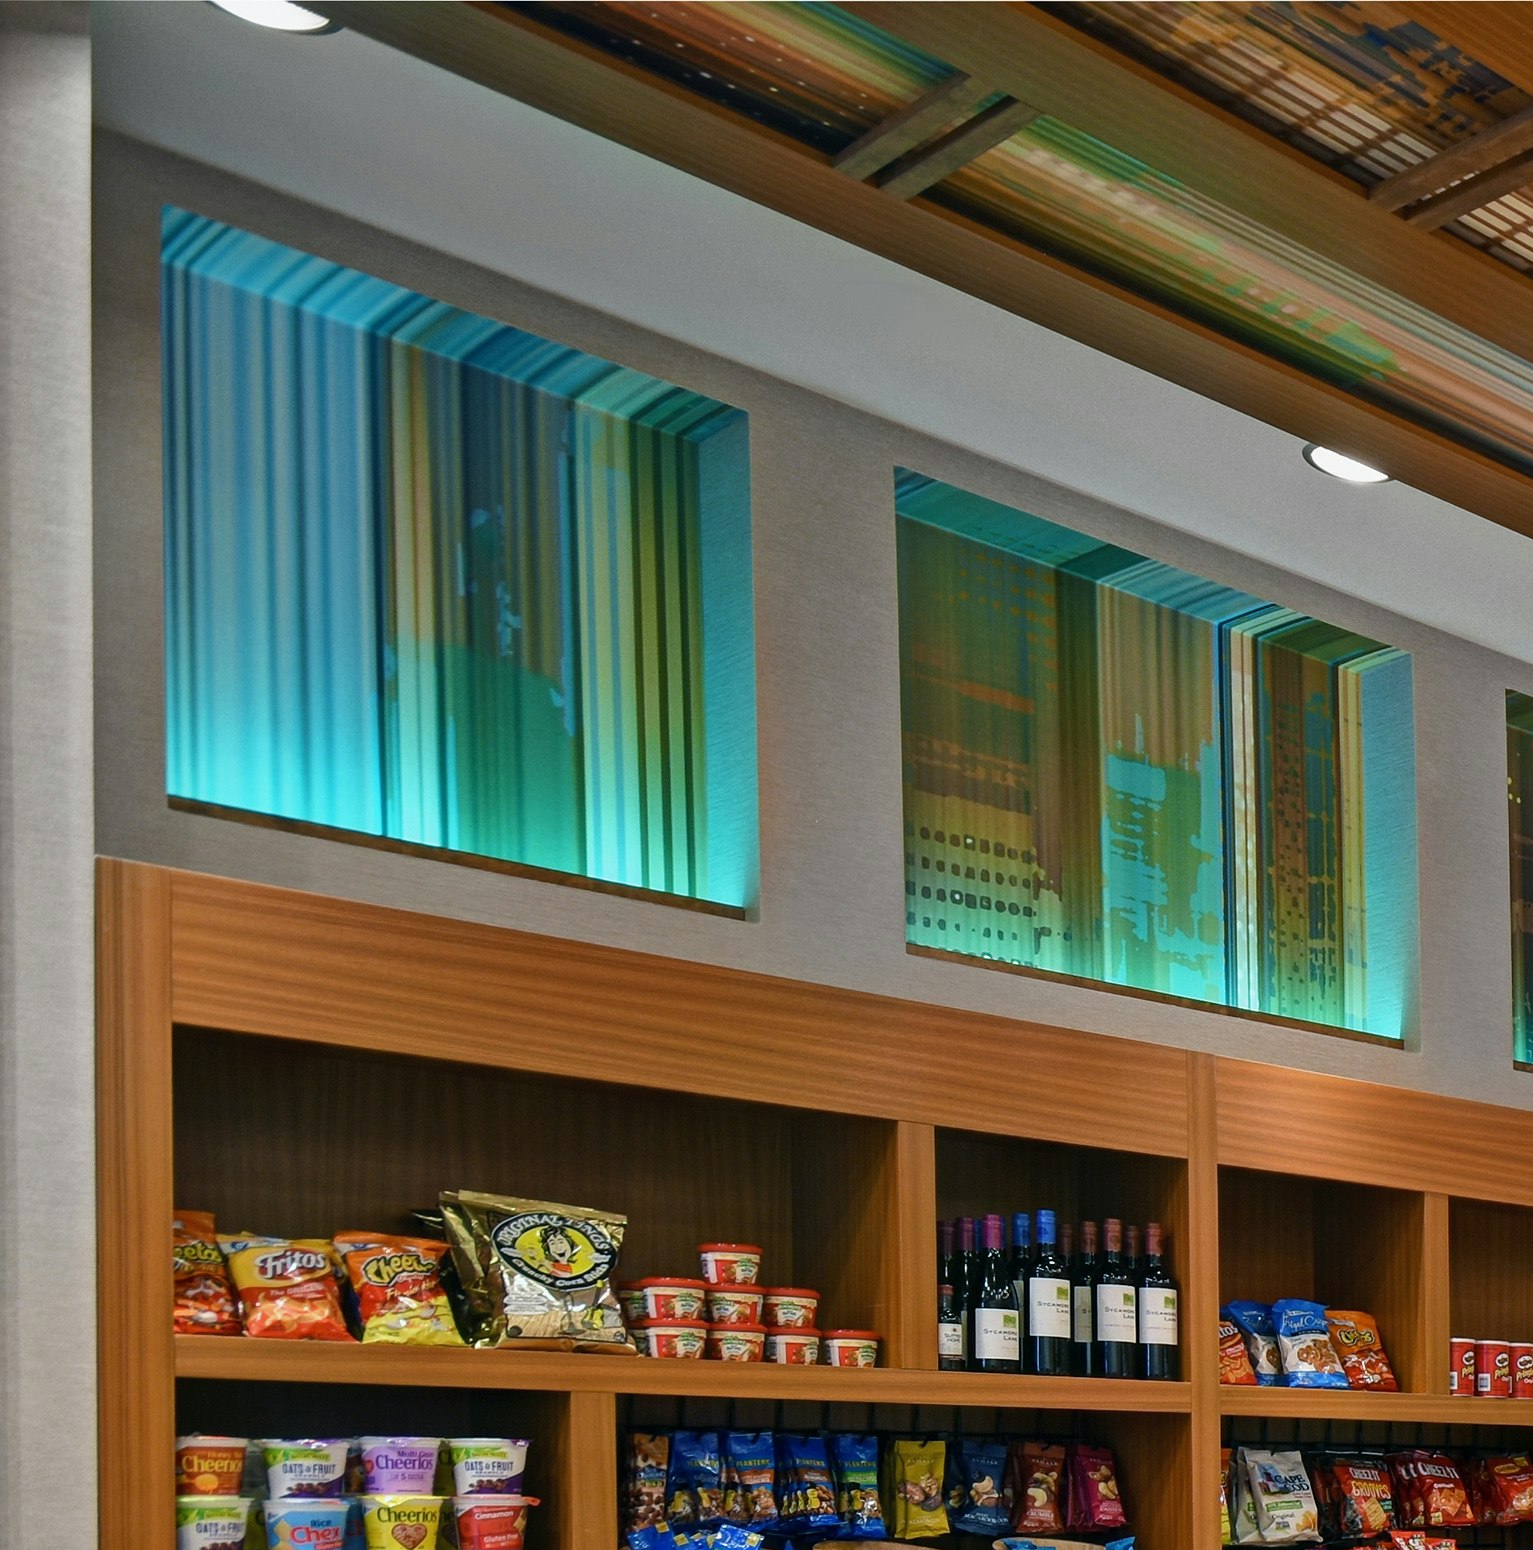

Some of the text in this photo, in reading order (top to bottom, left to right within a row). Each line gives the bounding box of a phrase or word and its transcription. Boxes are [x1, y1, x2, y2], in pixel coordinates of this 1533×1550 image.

[255, 1250, 326, 1279] Fritos
[512, 1259, 555, 1284] Crunchy
[555, 1277, 585, 1287] Corn
[375, 1455, 433, 1471] Cheerios
[465, 1461, 514, 1472] OATS FRUIT
[736, 1459, 769, 1467] PLANTERS
[282, 1464, 336, 1474] OATS FRUIT
[1274, 1474, 1306, 1484] CAPE
[1284, 1481, 1310, 1492] COD
[377, 1507, 437, 1523] Cheerios
[474, 1510, 514, 1521] Cinnamon
[290, 1526, 341, 1543] Chex
